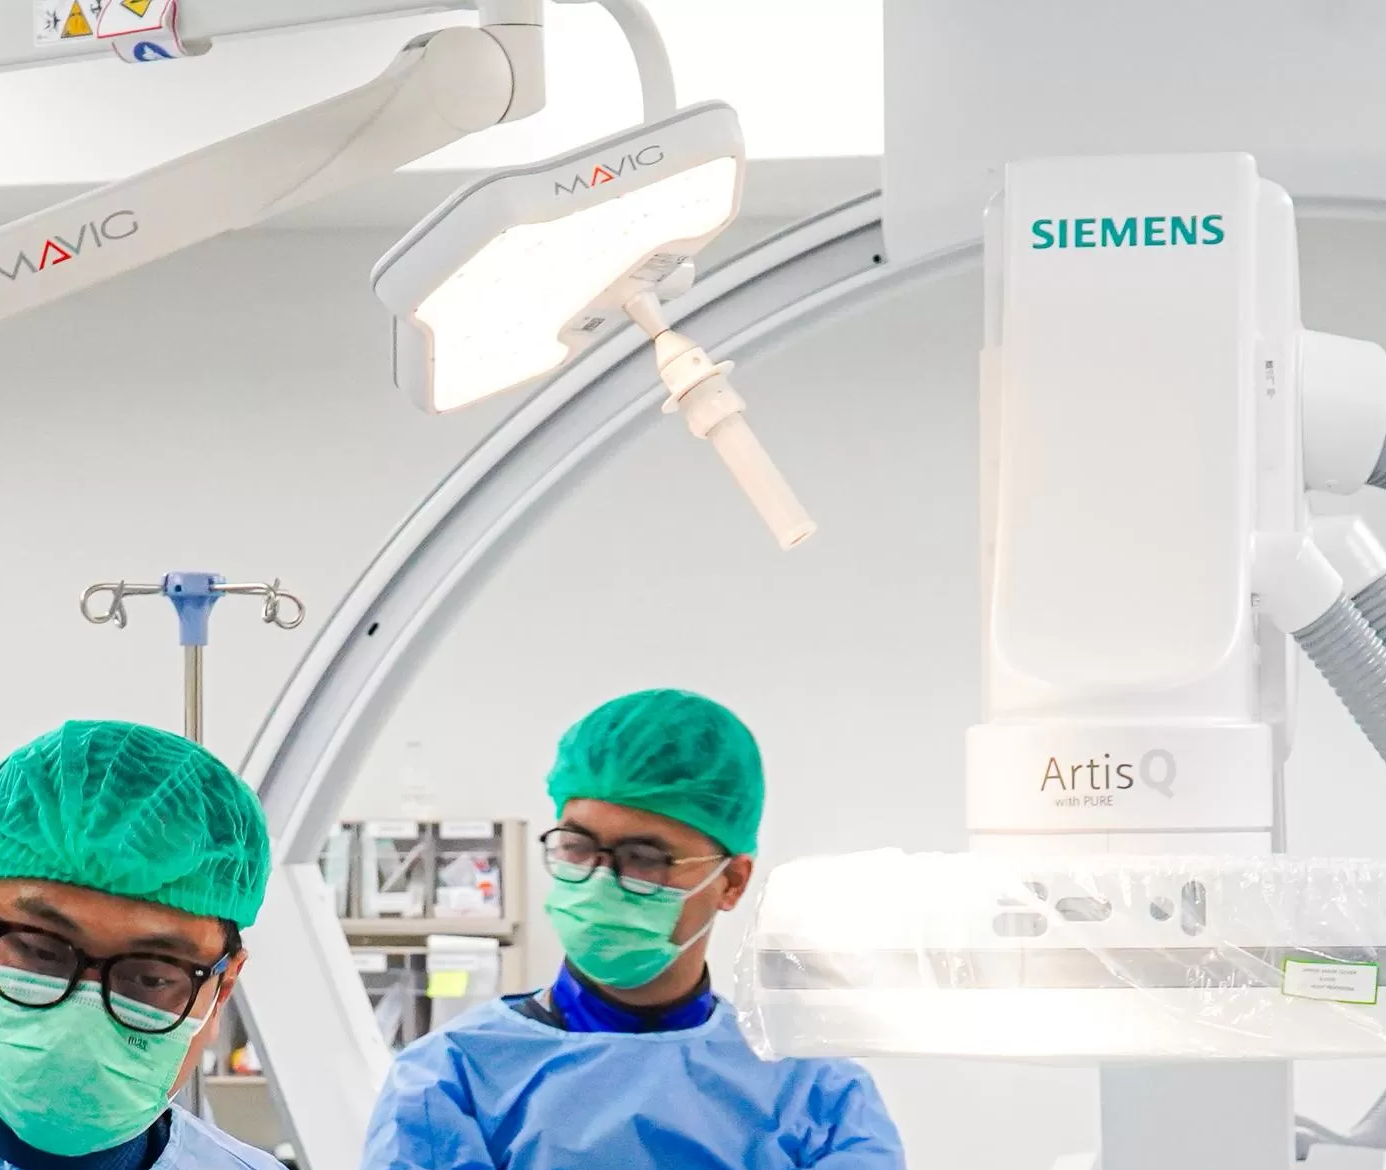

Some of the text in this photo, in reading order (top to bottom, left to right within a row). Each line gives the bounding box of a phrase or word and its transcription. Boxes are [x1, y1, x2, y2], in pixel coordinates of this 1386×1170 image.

[555, 145, 664, 196] MAVIG
[1031, 214, 1225, 249] SIEMENS
[1055, 795, 1114, 807] with PURE
